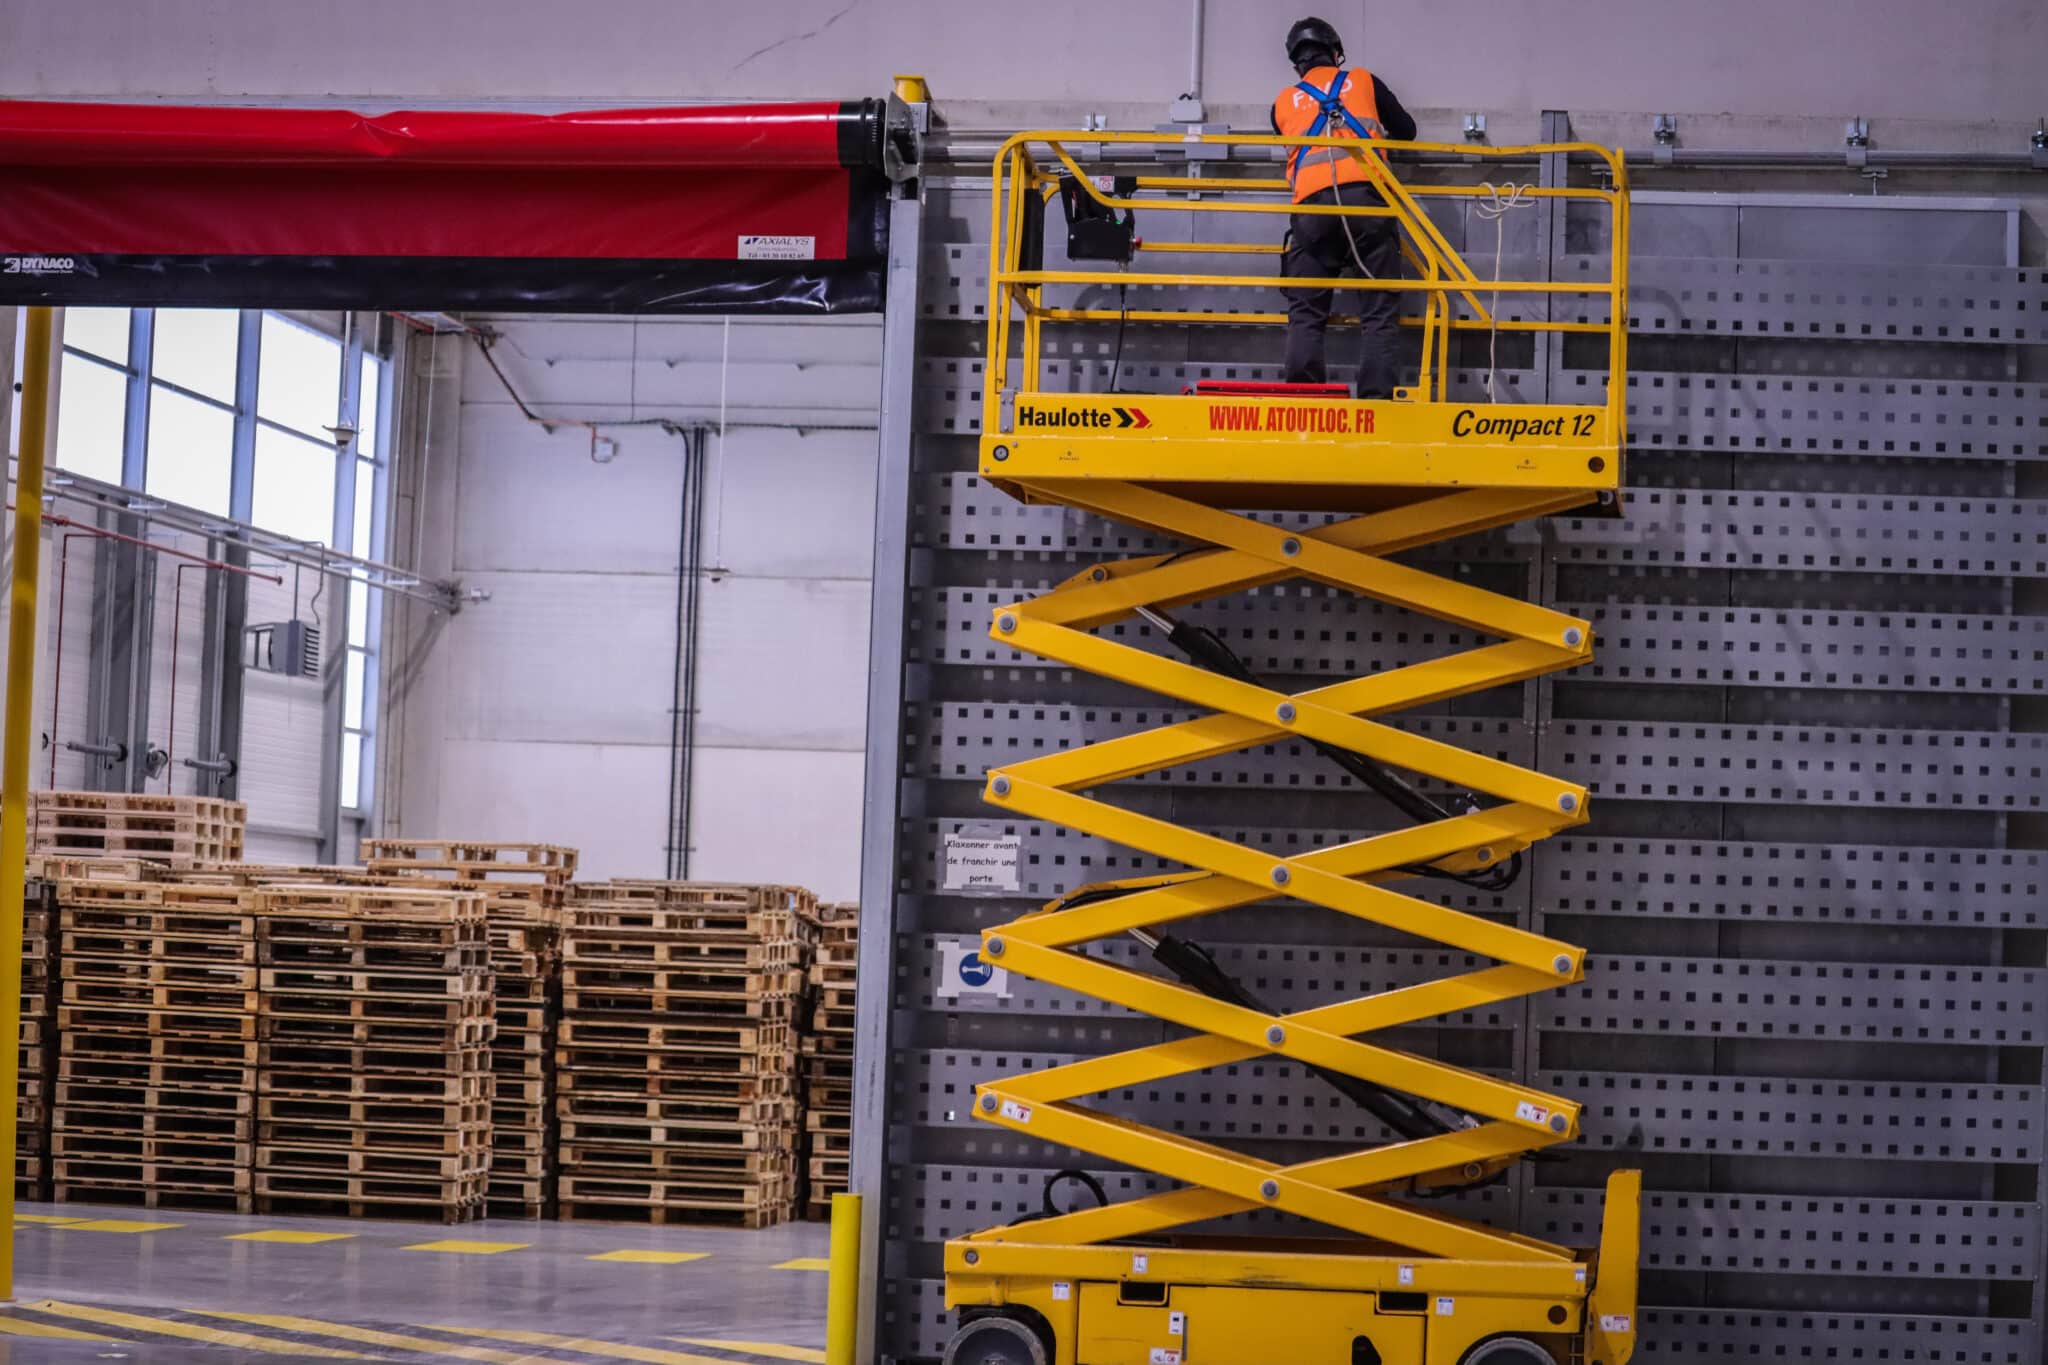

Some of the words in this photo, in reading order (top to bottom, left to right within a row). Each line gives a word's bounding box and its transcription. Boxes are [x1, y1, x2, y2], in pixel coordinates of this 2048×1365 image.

[22, 257, 74, 270] DYNACO
[1019, 406, 1112, 428] Haulotte
[1452, 409, 1565, 442] Compact
[1571, 414, 1596, 437] 12
[993, 842, 1018, 850] avant
[947, 857, 958, 865] de
[962, 857, 998, 866] franchir
[969, 875, 992, 884] porte
